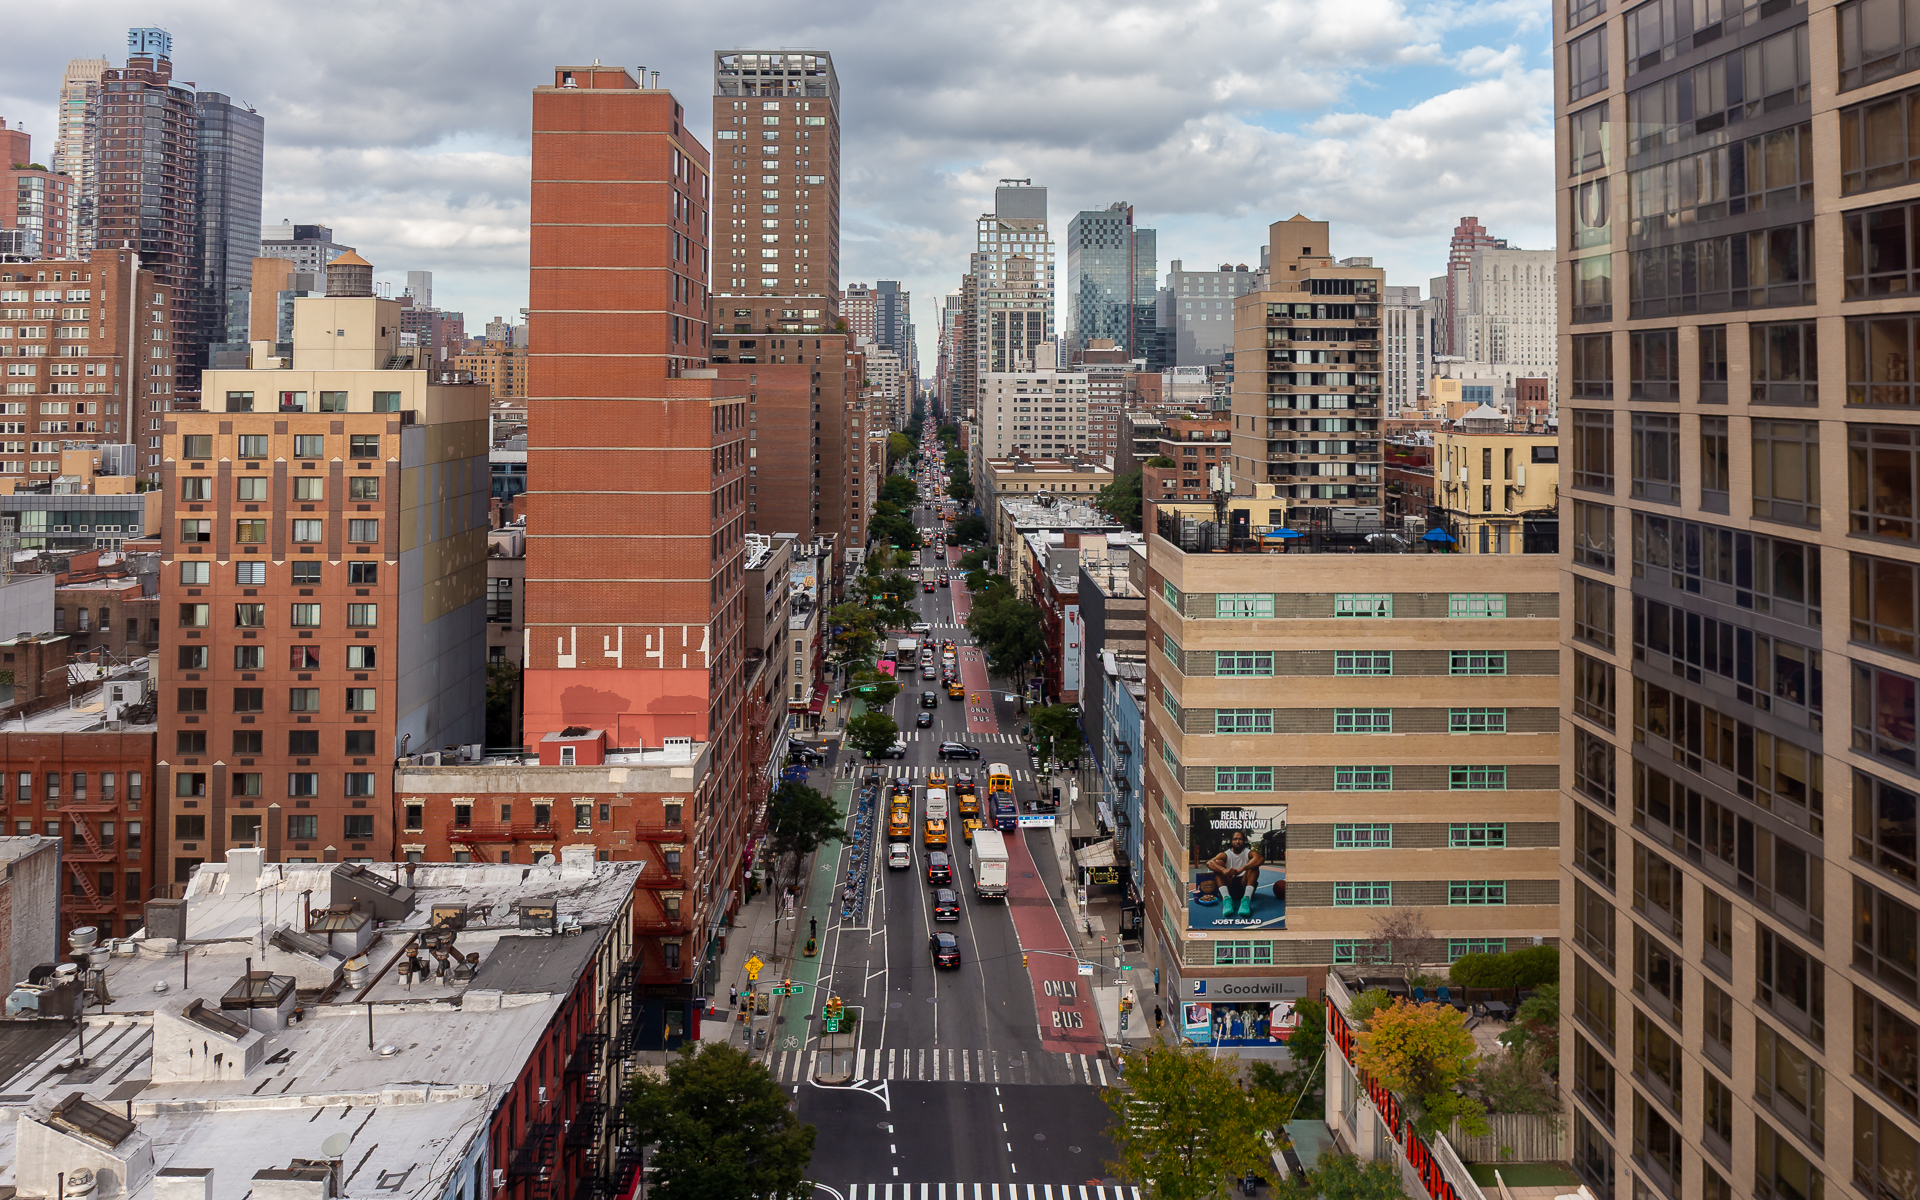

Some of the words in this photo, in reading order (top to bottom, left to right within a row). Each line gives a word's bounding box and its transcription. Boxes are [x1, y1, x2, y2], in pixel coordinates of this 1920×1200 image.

[1220, 810, 1238, 820] REAL
[1239, 810, 1257, 820] NEW
[1209, 820, 1242, 830] YORKERS
[1243, 820, 1267, 829] KNOW
[647, 987, 678, 995] STIRRED
[1043, 980, 1078, 998] ONLY
[1223, 983, 1283, 995] Goodwill
[1052, 1010, 1083, 1029] BUS
[1406, 1120, 1458, 1200] DEP
